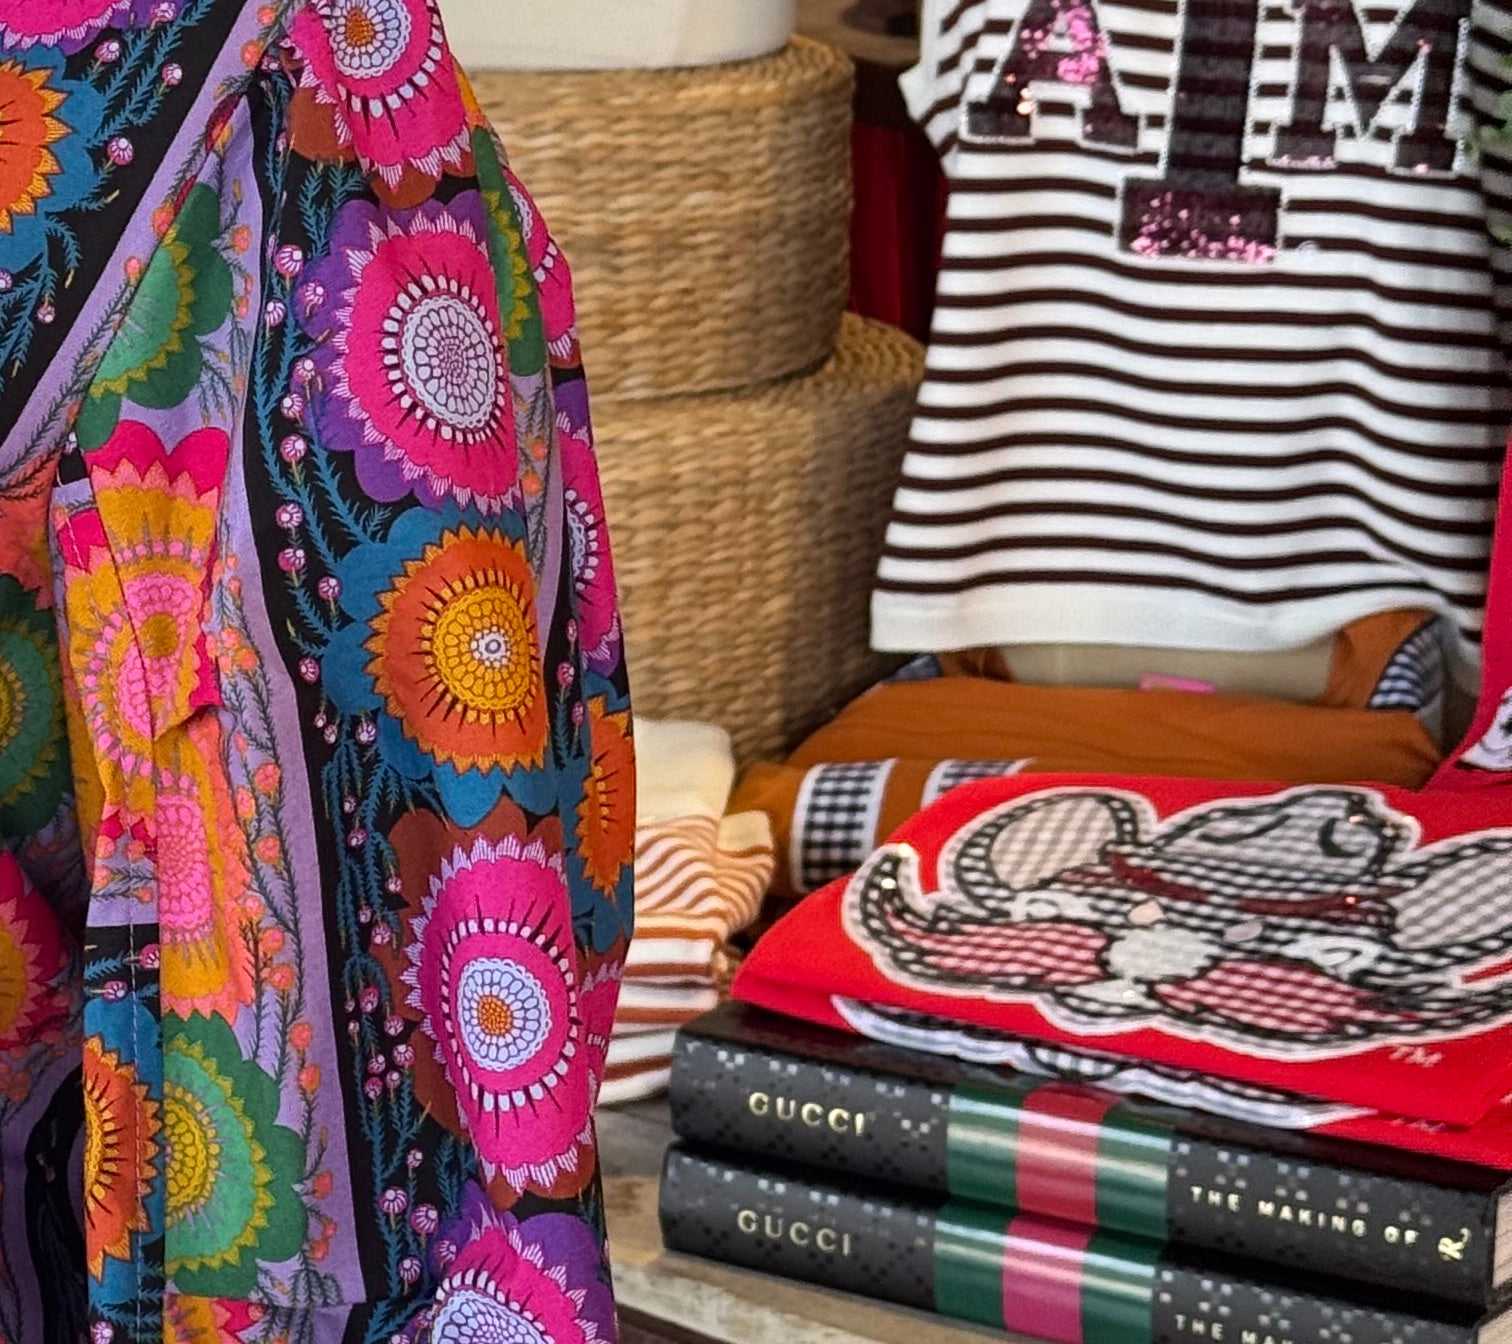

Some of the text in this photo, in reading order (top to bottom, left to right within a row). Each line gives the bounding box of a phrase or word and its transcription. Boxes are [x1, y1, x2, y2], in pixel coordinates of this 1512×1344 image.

[749, 1092, 865, 1136] GUCCI
[737, 1210, 851, 1256] GUCCI
[1190, 1186, 1240, 1212] THE
[1258, 1200, 1367, 1237] MAKING
[1384, 1226, 1419, 1245] OF
[1175, 1314, 1223, 1340] THE
